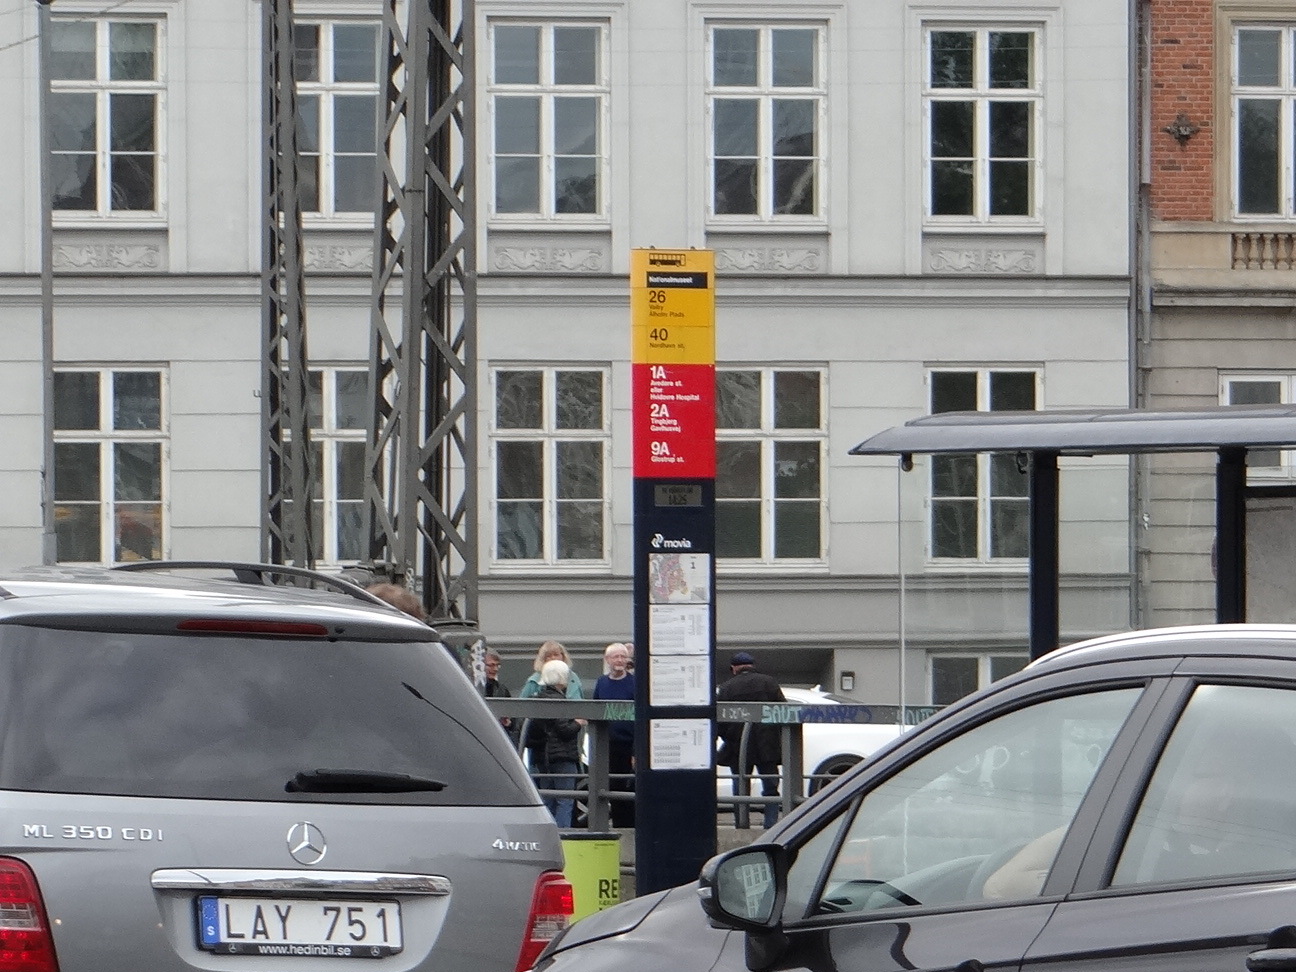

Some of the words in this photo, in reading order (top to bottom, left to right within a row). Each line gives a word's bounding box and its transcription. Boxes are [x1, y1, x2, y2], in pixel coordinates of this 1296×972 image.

[648, 290, 667, 303] 26
[650, 328, 669, 341] 40
[650, 365, 667, 379] 1A
[650, 403, 670, 418] 2A
[651, 441, 670, 456] 9A
[664, 538, 692, 548] movia
[23, 824, 54, 839] ML
[61, 825, 112, 840] 350
[121, 827, 164, 842] CDI
[224, 903, 292, 940] LAY
[322, 906, 388, 943] 751
[206, 926, 216, 937] S
[257, 943, 352, 957] www.hedinbil.se
